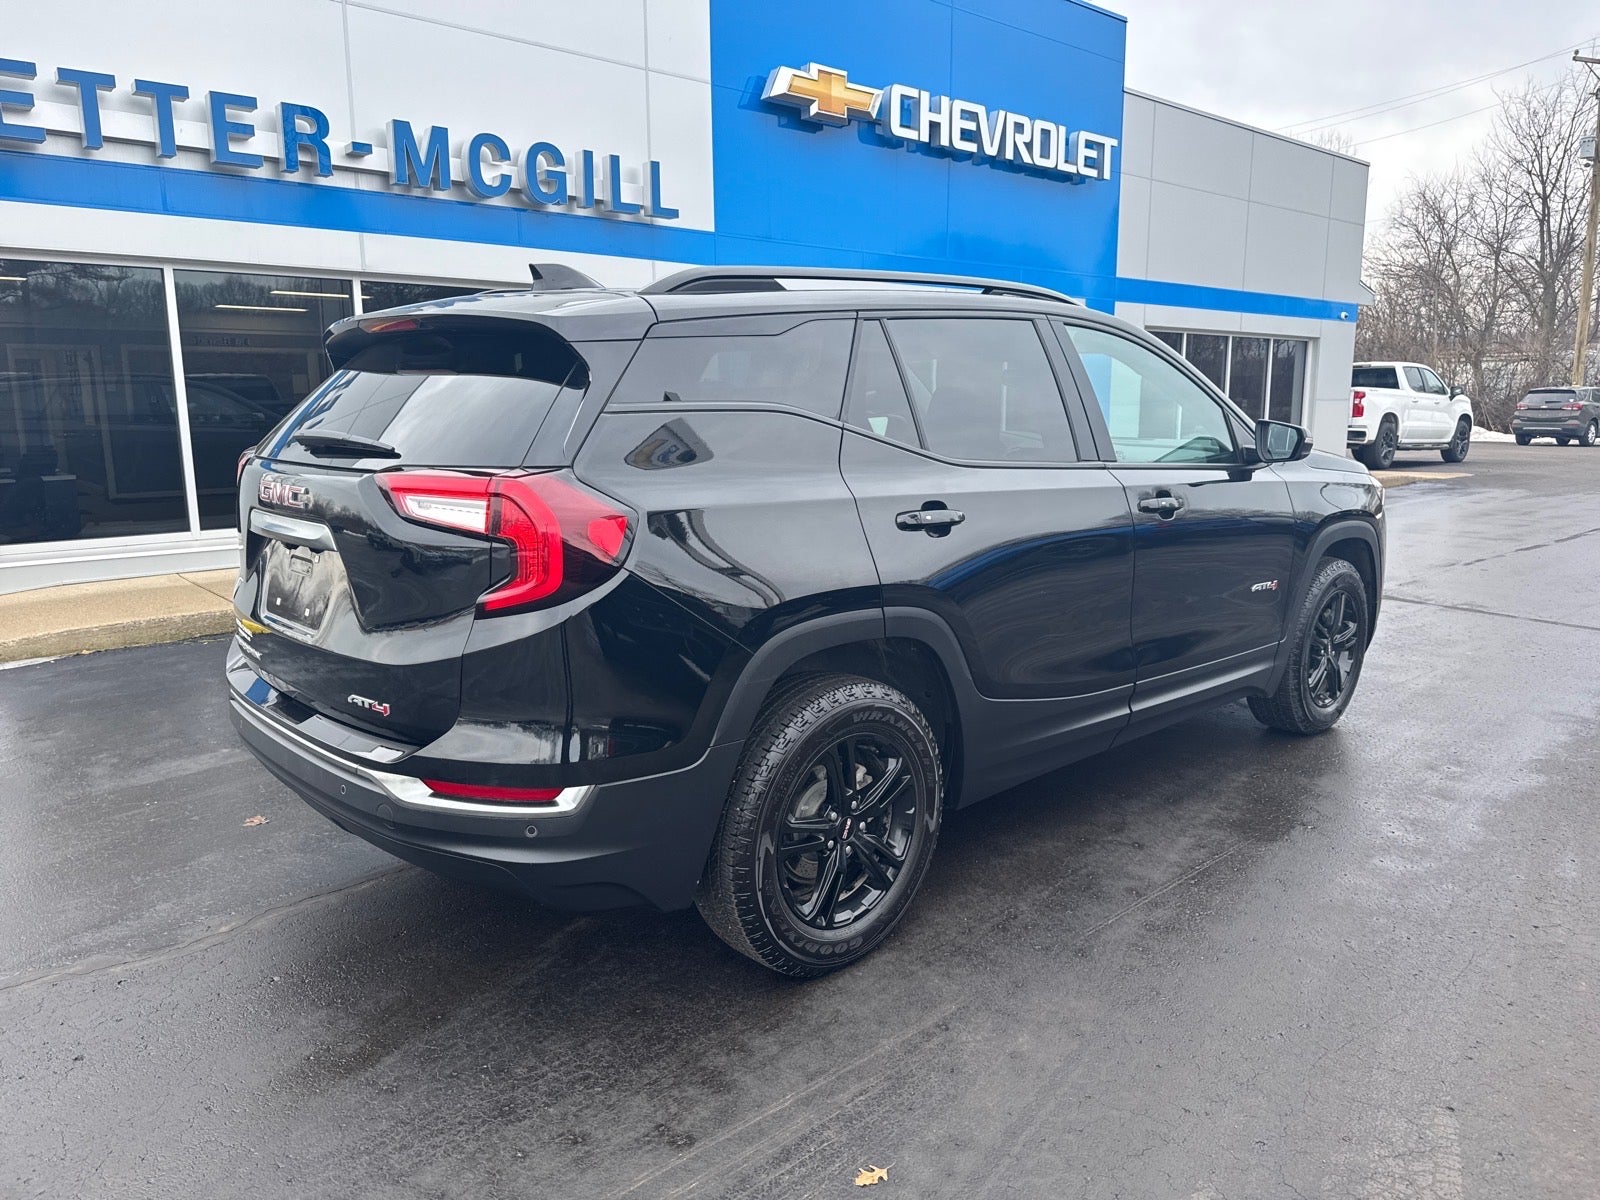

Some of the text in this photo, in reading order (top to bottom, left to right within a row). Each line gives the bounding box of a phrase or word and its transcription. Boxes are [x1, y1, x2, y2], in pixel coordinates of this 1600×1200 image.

[886, 84, 1118, 181] CHEVROLET
[260, 476, 310, 509] GMC
[1251, 580, 1278, 592] AT4
[347, 694, 390, 717] AT4
